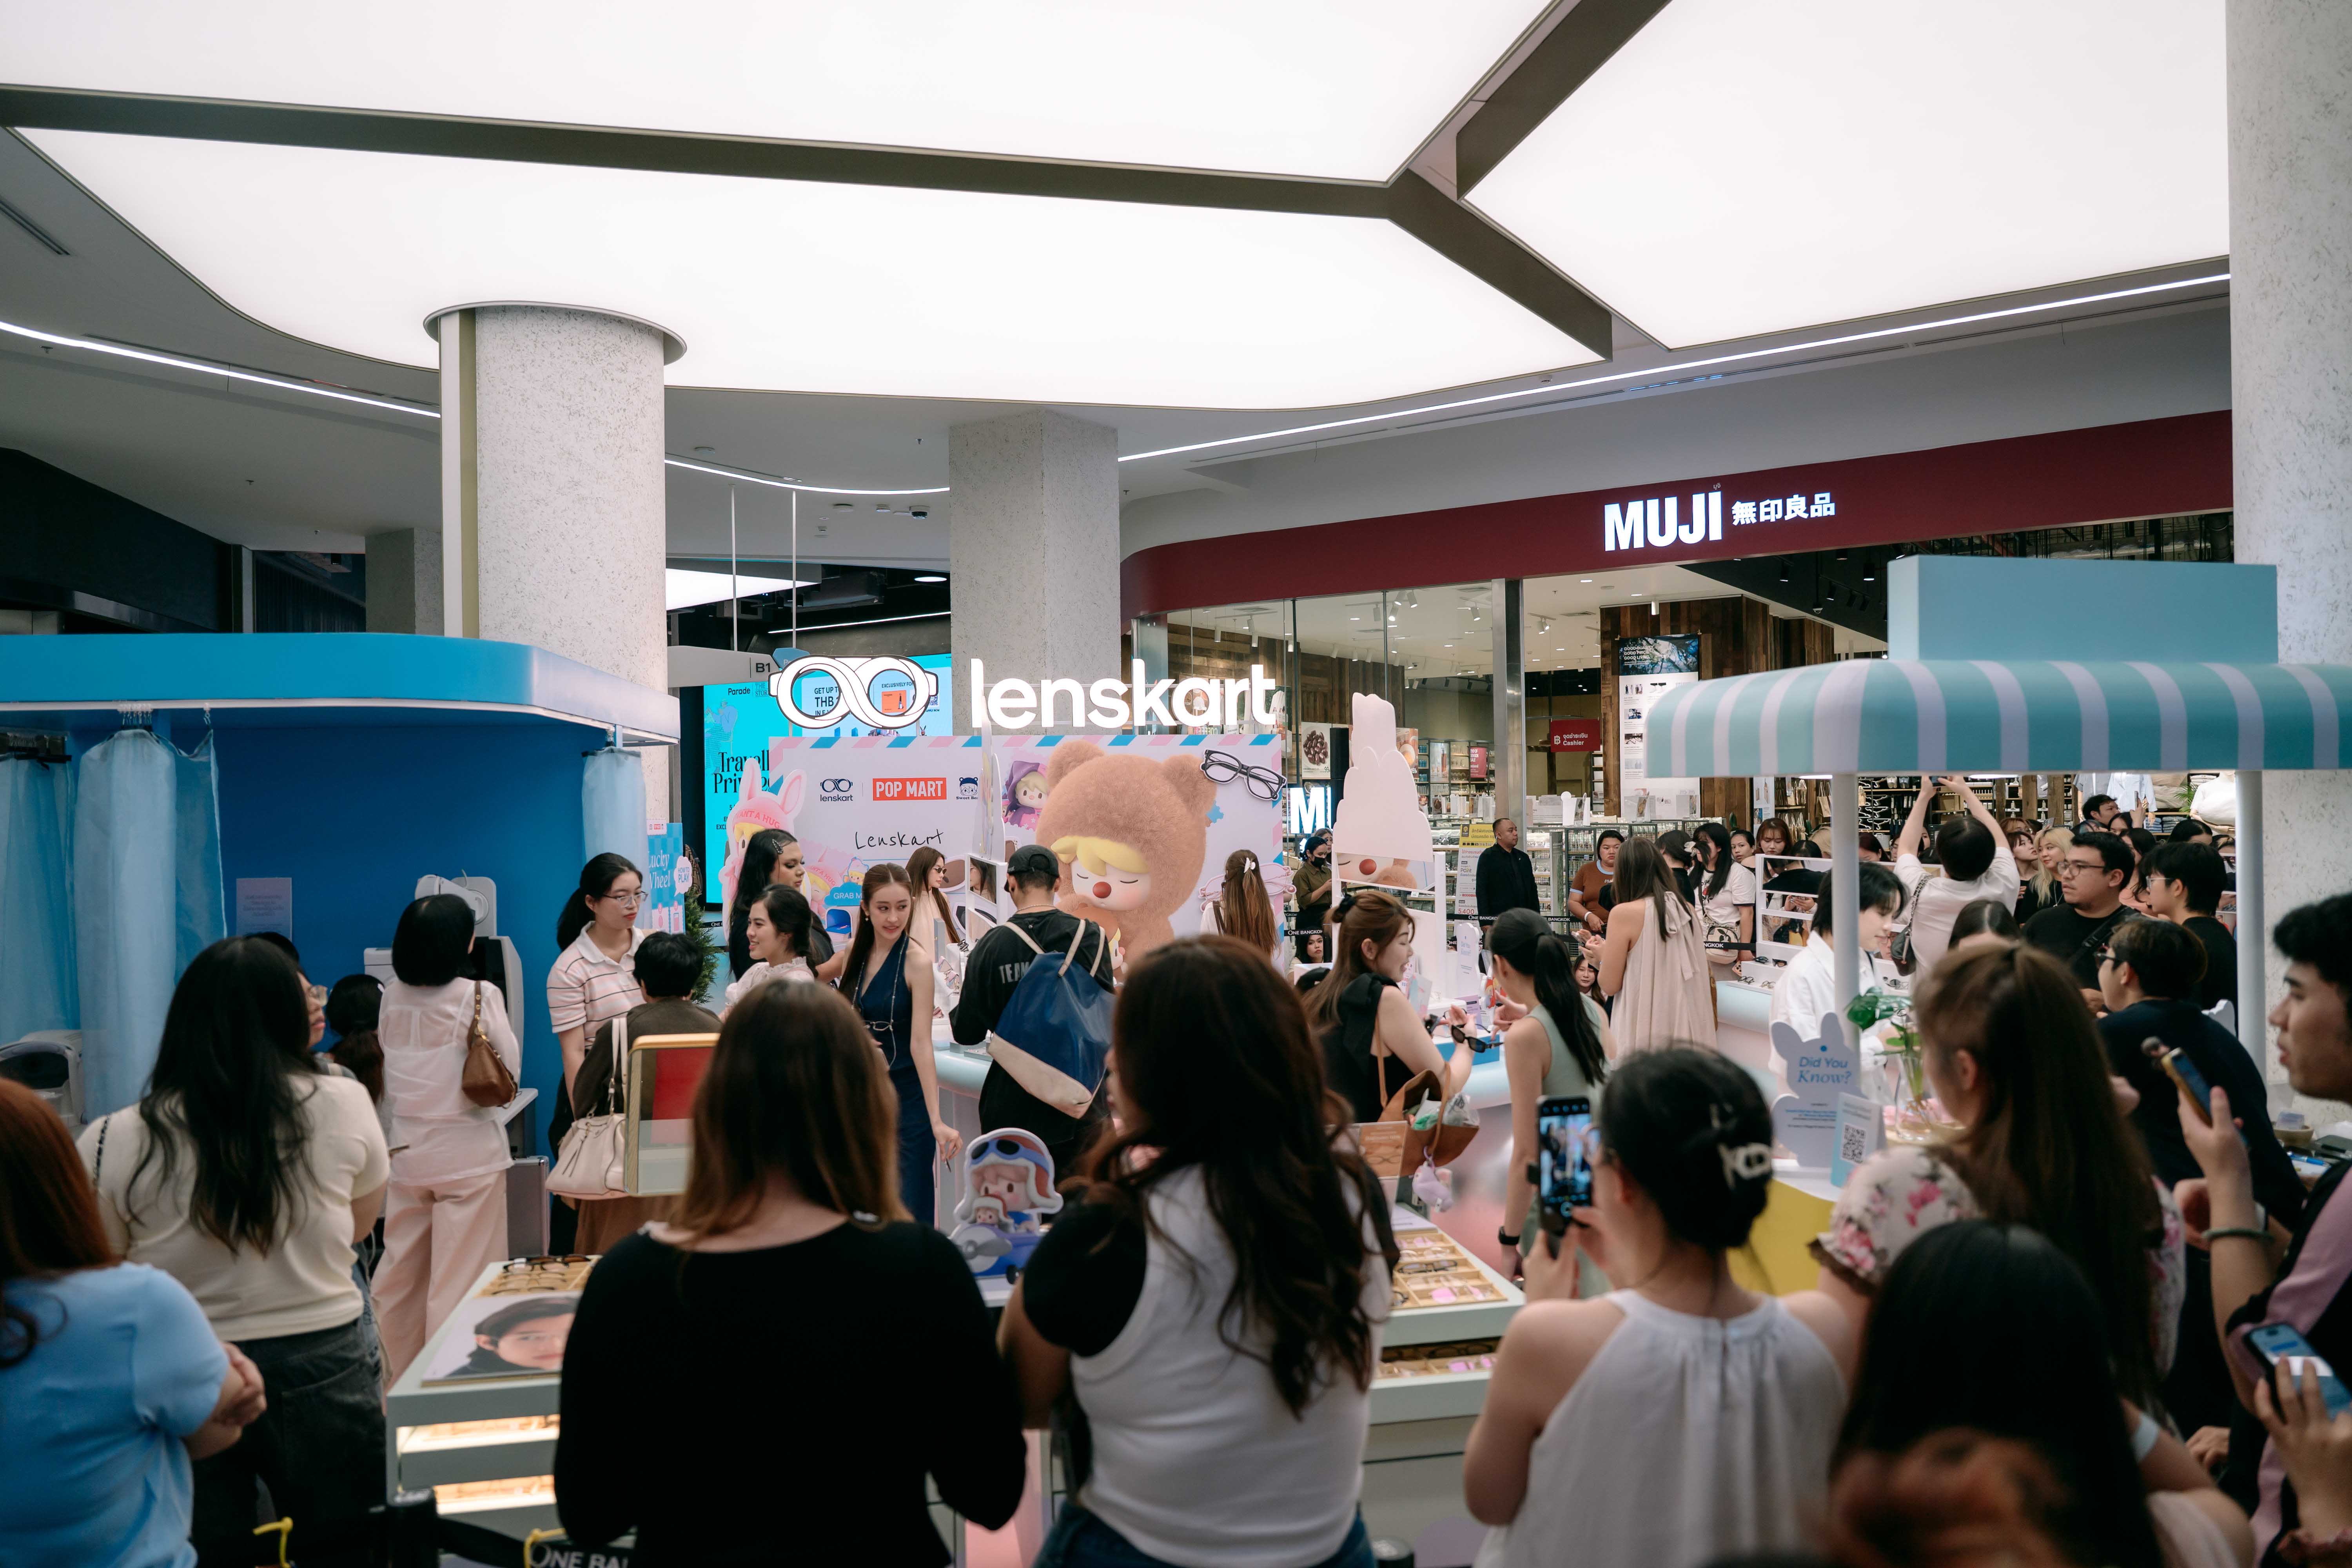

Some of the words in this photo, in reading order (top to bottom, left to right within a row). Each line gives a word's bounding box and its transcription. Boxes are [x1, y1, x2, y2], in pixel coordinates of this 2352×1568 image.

[1731, 492, 1835, 525] 無印良品
[1604, 491, 1722, 552] MUJI
[756, 662, 771, 673] B1
[728, 687, 750, 696] Parade
[971, 659, 1276, 729] lenskart
[815, 697, 834, 708] THB
[876, 781, 902, 798] POP
[906, 781, 943, 797] MART
[763, 814, 780, 828] HUG
[855, 829, 944, 849] Lenskart
[678, 873, 690, 883] PLAY
[1798, 1057, 1821, 1068] Did
[1825, 1058, 1848, 1068] You
[1797, 1070, 1852, 1084] Know?
